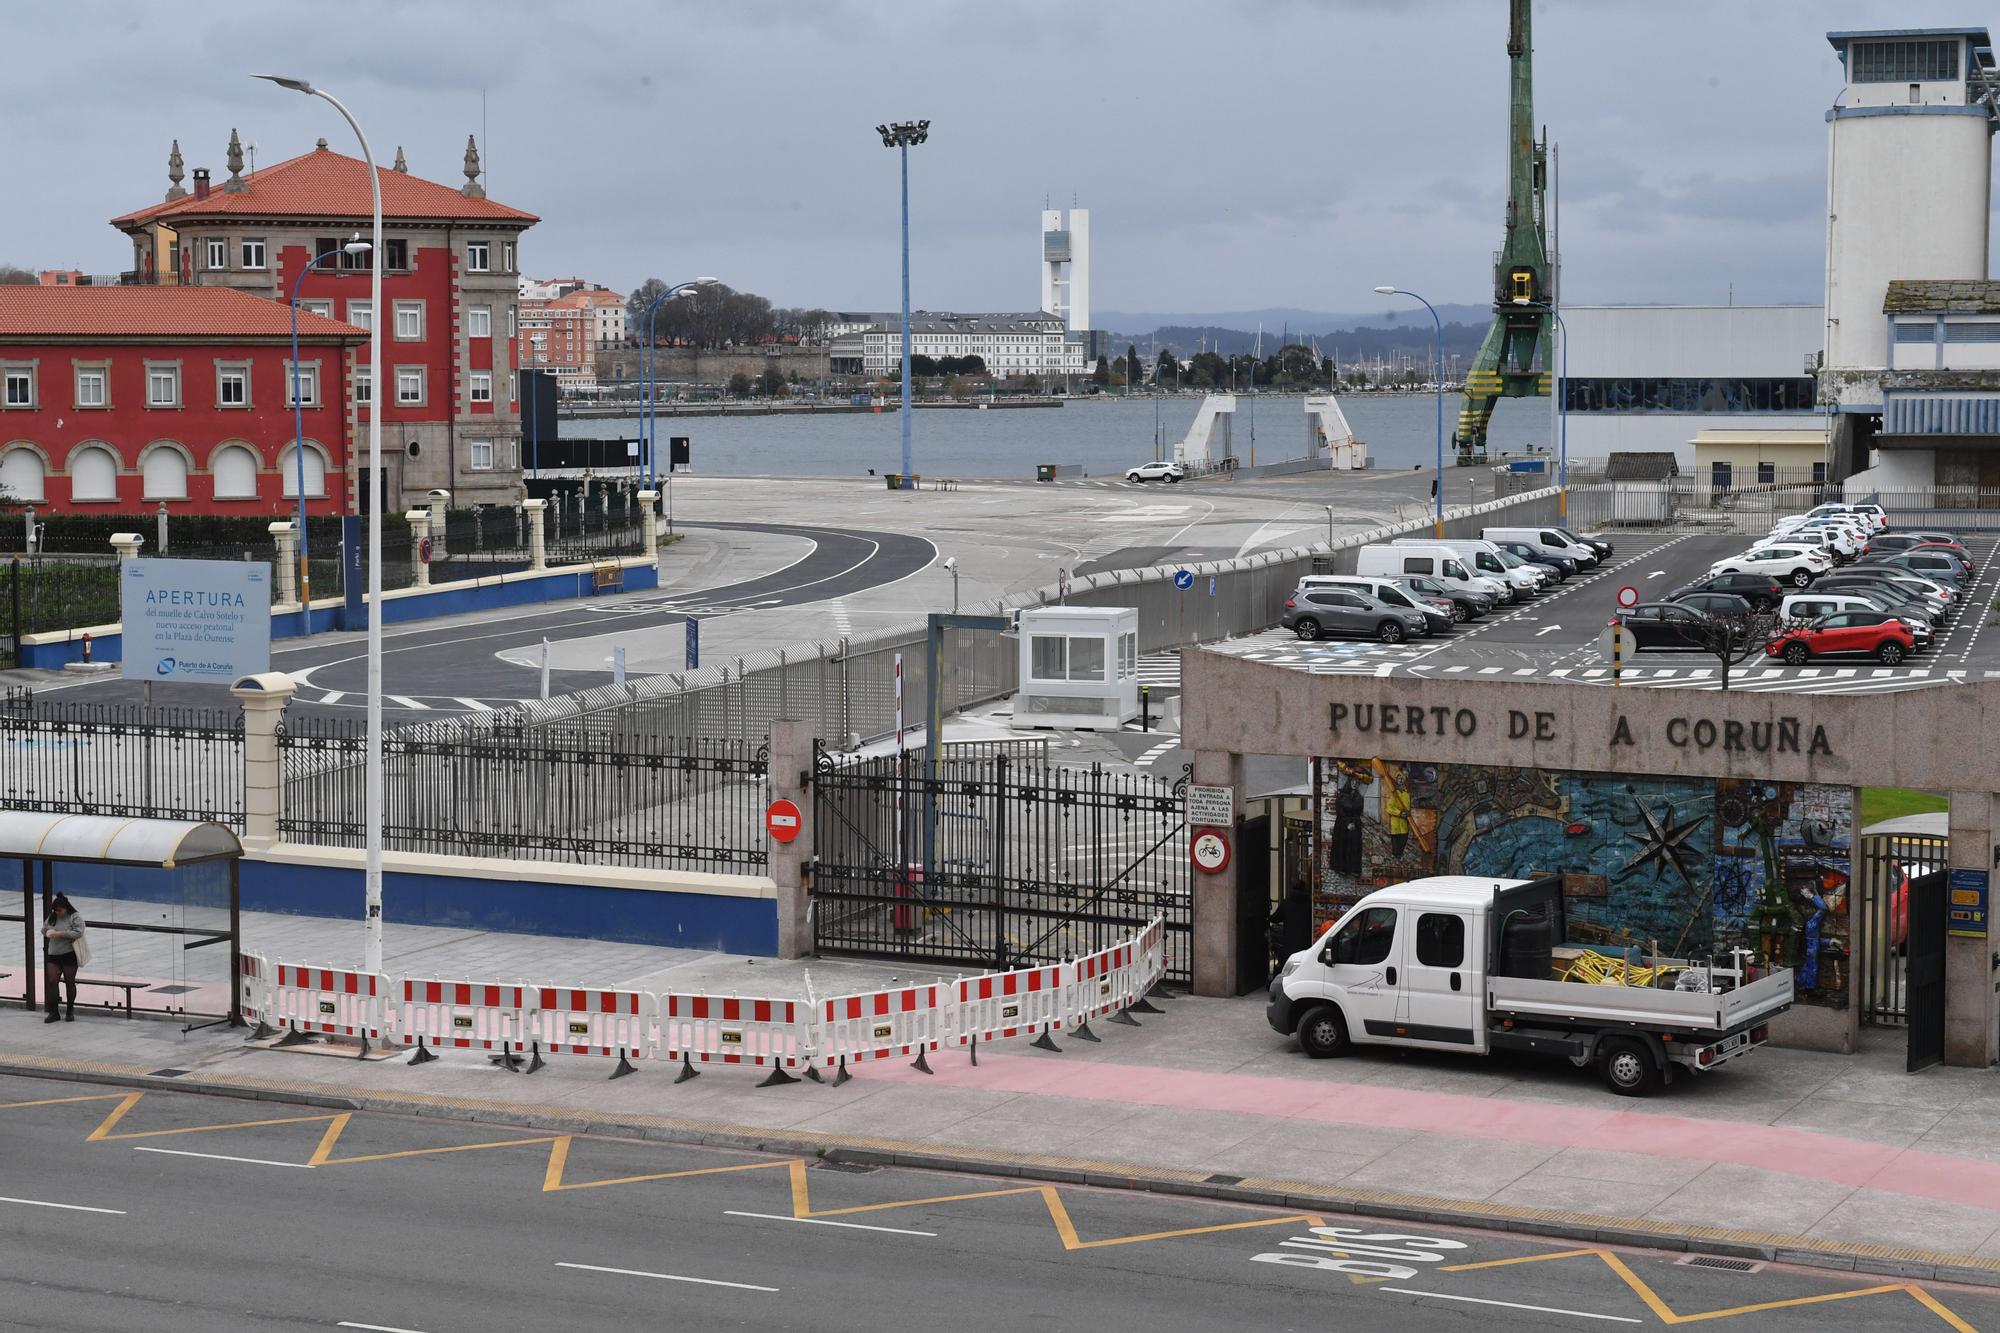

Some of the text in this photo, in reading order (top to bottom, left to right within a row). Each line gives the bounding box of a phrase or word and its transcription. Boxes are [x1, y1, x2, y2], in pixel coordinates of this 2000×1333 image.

[146, 590, 244, 607] APERTURA
[145, 608, 245, 624] del muelle de Calvo Sotelo y
[156, 622, 178, 630] nuevo
[203, 623, 234, 632] peatonal
[165, 631, 172, 640] la
[173, 632, 192, 641] Plaza
[194, 633, 203, 641] de
[204, 634, 235, 643] Ourense
[1329, 702, 1833, 755] PUERTO DE A CORUÑA
[1249, 1226, 1468, 1279] BUS
